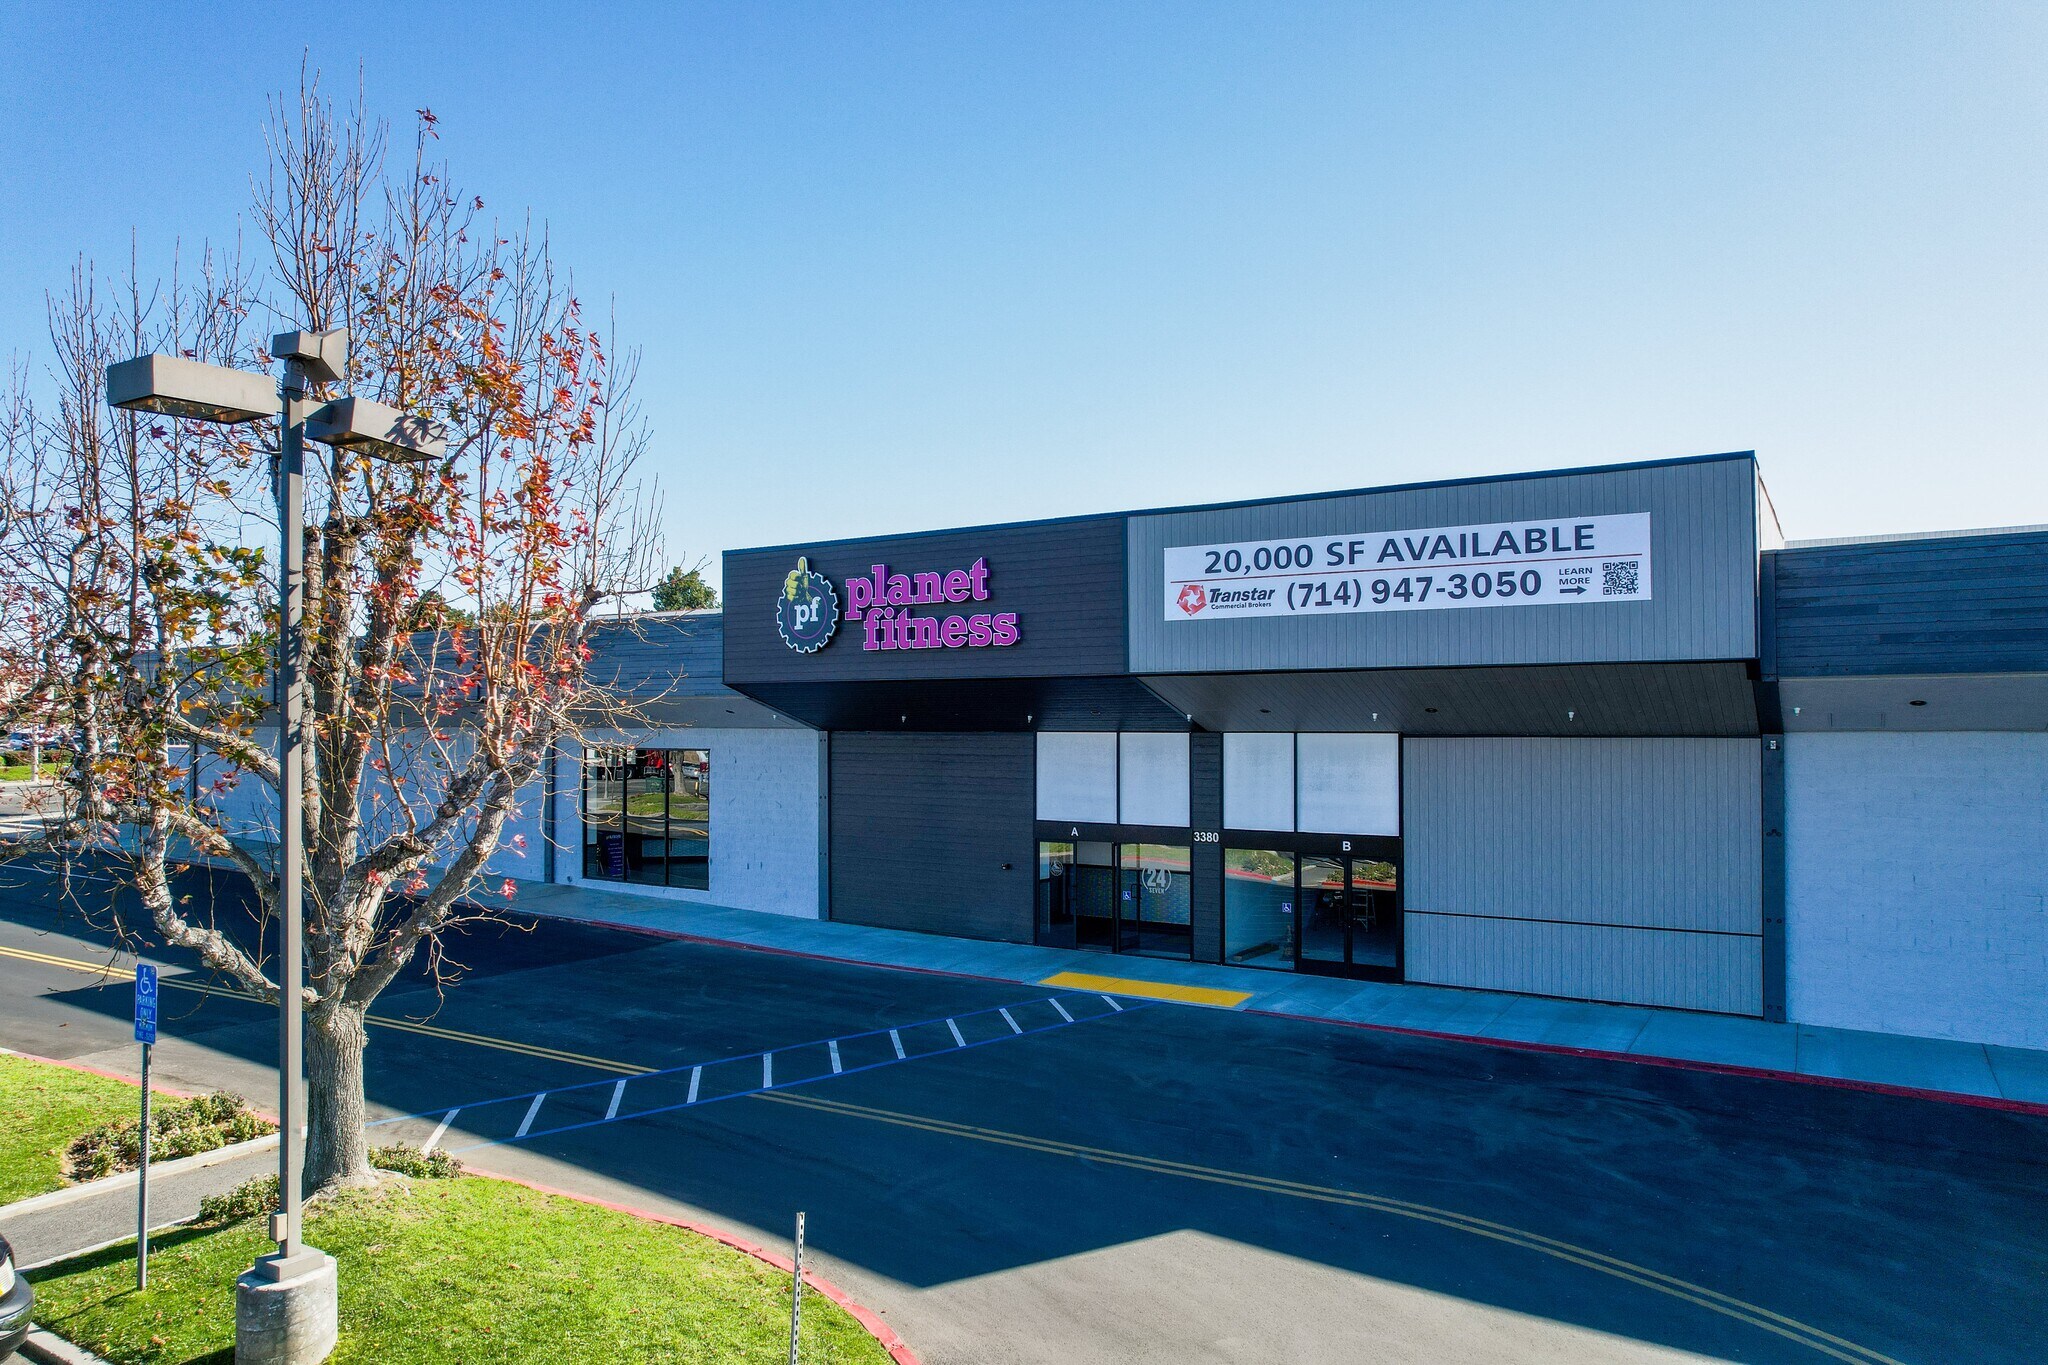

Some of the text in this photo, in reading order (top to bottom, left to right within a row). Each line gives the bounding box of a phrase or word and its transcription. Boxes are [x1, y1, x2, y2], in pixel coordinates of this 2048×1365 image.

[1204, 524, 1595, 575] 20,000 SF AVAILABLE
[1558, 567, 1593, 576] LEARN
[844, 556, 990, 621] planet
[1558, 577, 1591, 585] MORE
[1209, 587, 1275, 603] Transtar
[1287, 569, 1542, 611] (714) 947-3050
[794, 596, 821, 630] pf
[1210, 602, 1247, 610] Commercial
[863, 607, 1020, 650] fitness
[1070, 827, 1079, 837] A
[1193, 831, 1220, 843] 3380
[1342, 841, 1352, 851] B
[1146, 867, 1167, 888] 24
